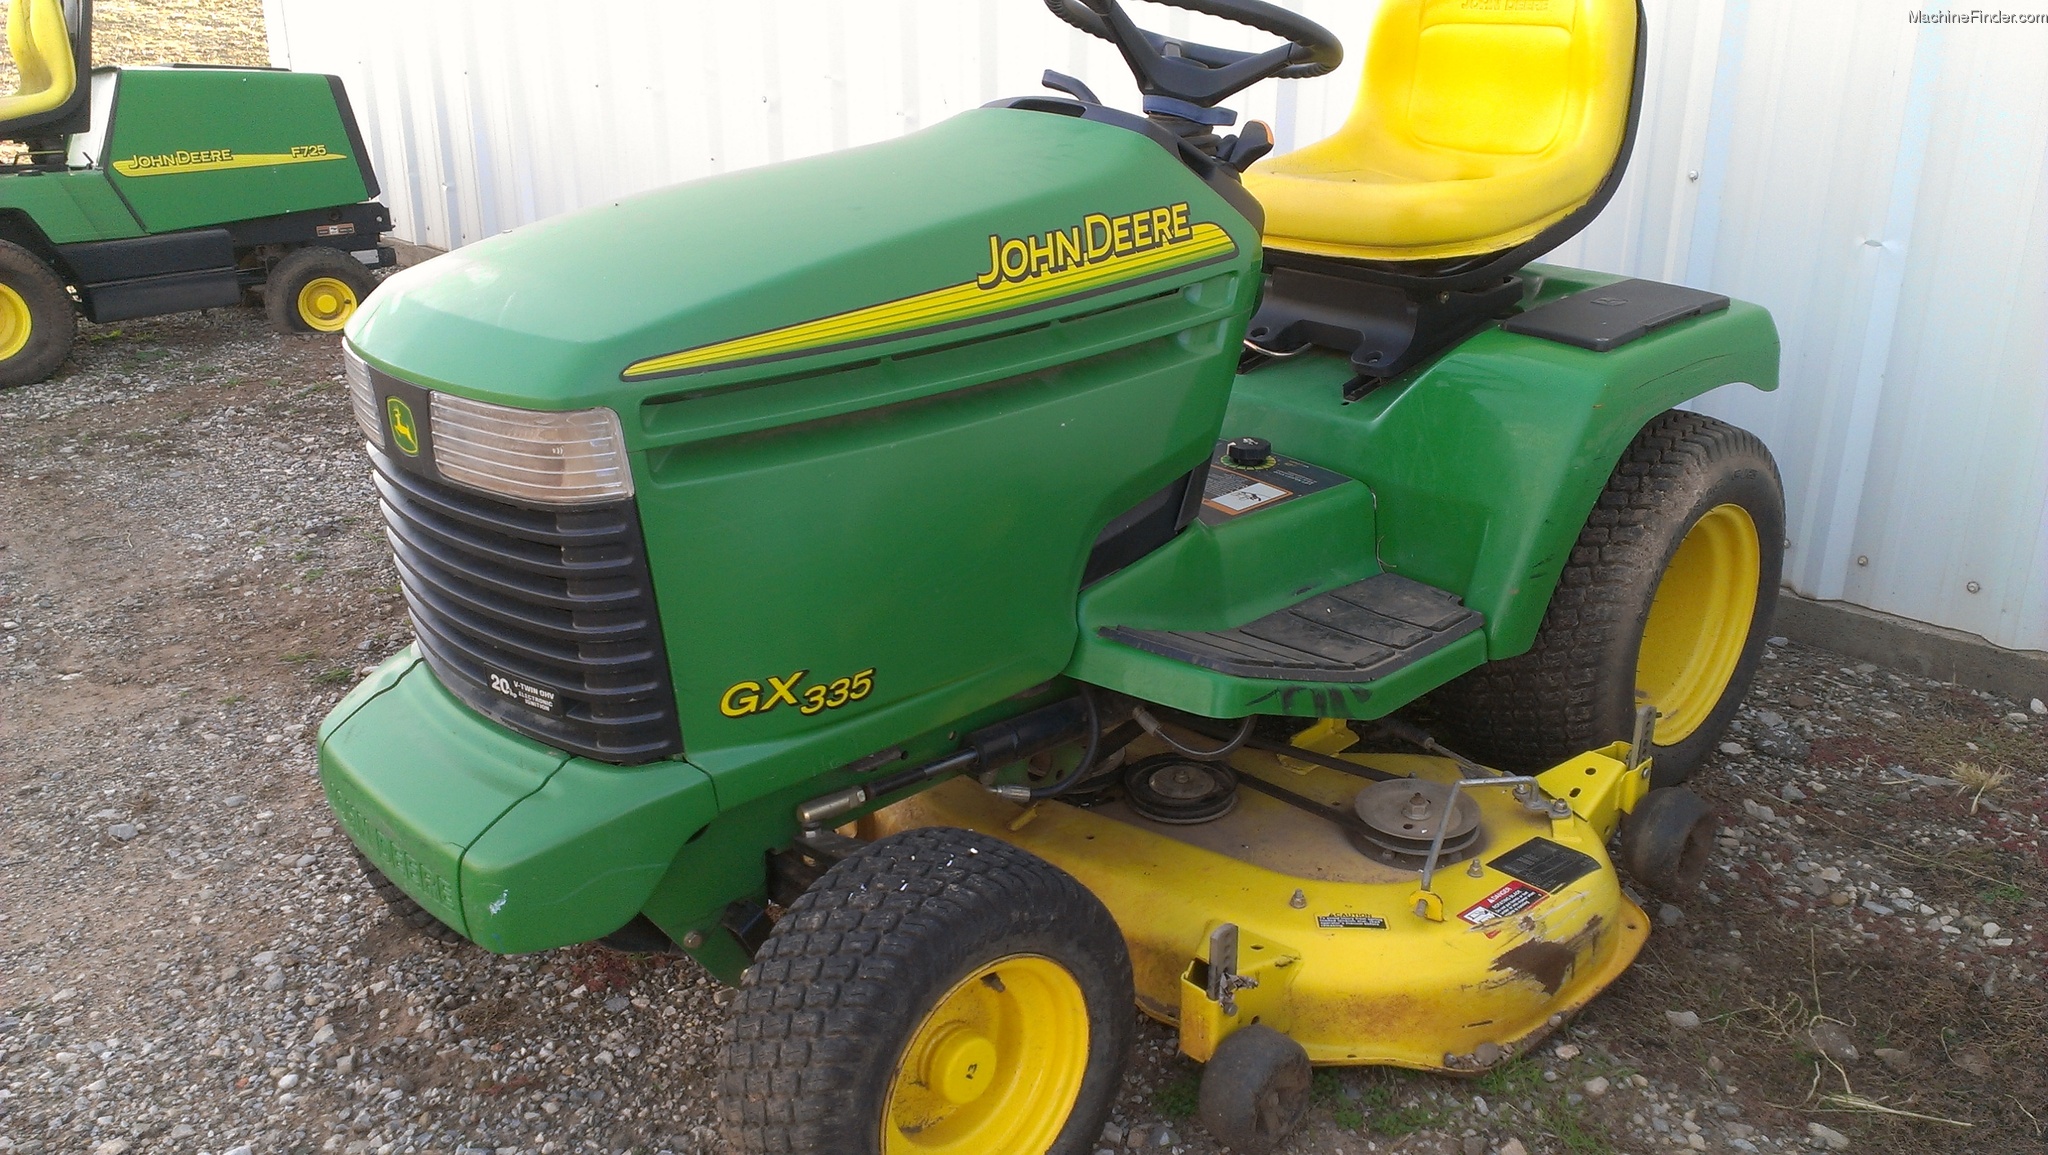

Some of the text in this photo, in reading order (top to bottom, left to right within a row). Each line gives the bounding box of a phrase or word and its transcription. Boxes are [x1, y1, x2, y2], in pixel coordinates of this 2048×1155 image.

[129, 144, 327, 169] JOHN DEERE F725
[977, 201, 1194, 290] JOHN DEERE
